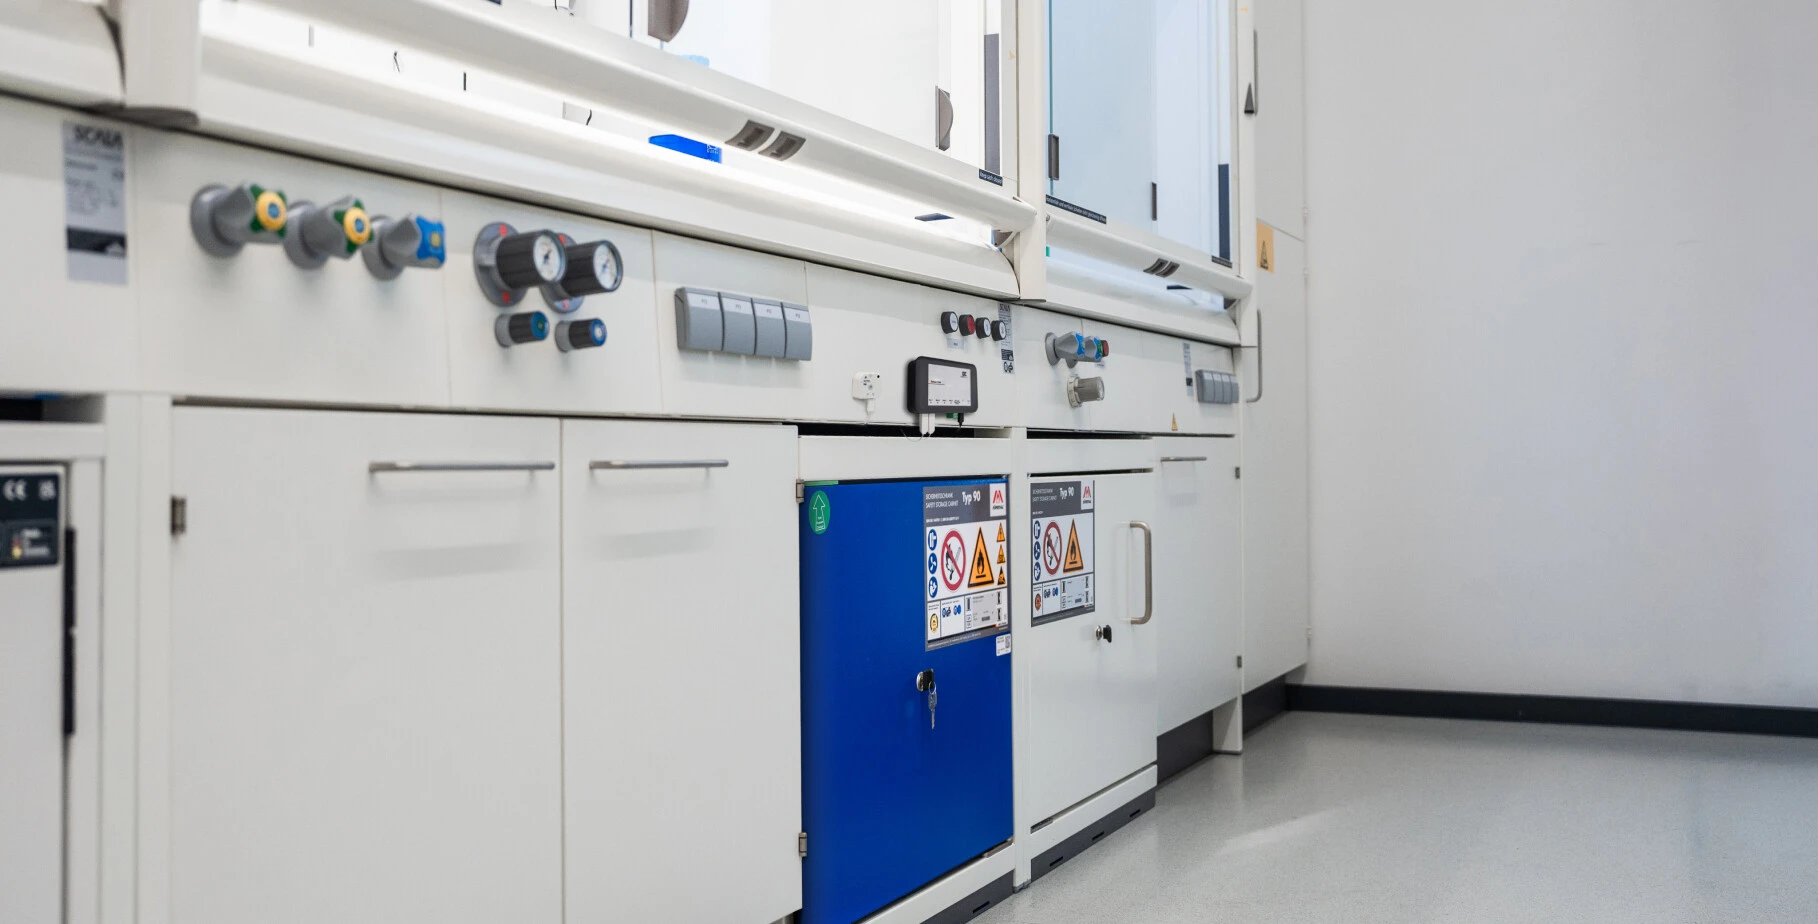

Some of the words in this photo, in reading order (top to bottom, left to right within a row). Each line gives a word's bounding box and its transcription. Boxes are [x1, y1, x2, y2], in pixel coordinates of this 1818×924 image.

[962, 491, 972, 506] Typ
[973, 490, 981, 502] 90
[1059, 487, 1068, 500] Typ
[1068, 486, 1075, 497] 90
